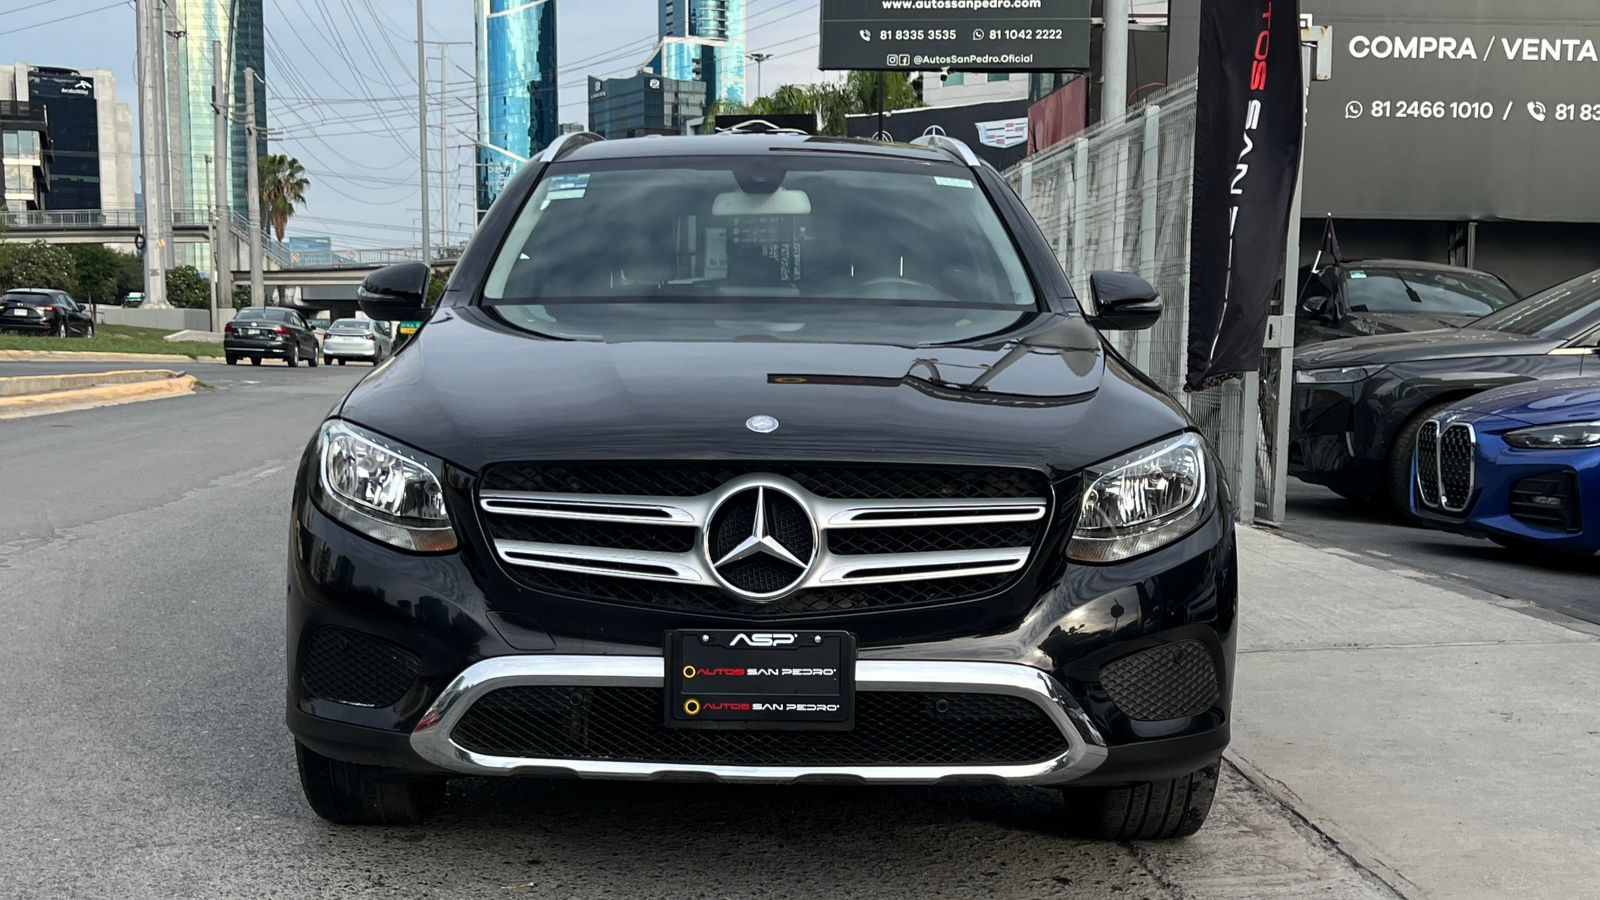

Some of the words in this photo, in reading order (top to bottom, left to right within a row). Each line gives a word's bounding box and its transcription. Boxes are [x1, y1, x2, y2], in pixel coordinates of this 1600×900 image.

[881, 0, 1042, 11] www.autossanpedro.com
[879, 30, 892, 40] 81
[895, 29, 925, 41] 8335
[927, 29, 957, 40] 3535
[989, 29, 1001, 40] 81
[1004, 29, 1033, 40] 1042
[1035, 28, 1063, 40] 2222
[1348, 35, 1478, 60] COMPRA
[1501, 38, 1599, 62] VENTA
[913, 53, 1034, 65] @AutosSanPedro.Oficial
[1370, 100, 1391, 118] 81
[1395, 100, 1445, 119] 2466
[1449, 101, 1494, 119] 1010
[1554, 103, 1575, 121] 81
[729, 633, 795, 647] ASP
[697, 668, 745, 676] AUTOS
[746, 668, 779, 676] SAN
[781, 668, 835, 676] PEDRO
[702, 703, 751, 711] AUTOS
[752, 703, 784, 711] SAN
[786, 703, 838, 712] PEDRO
